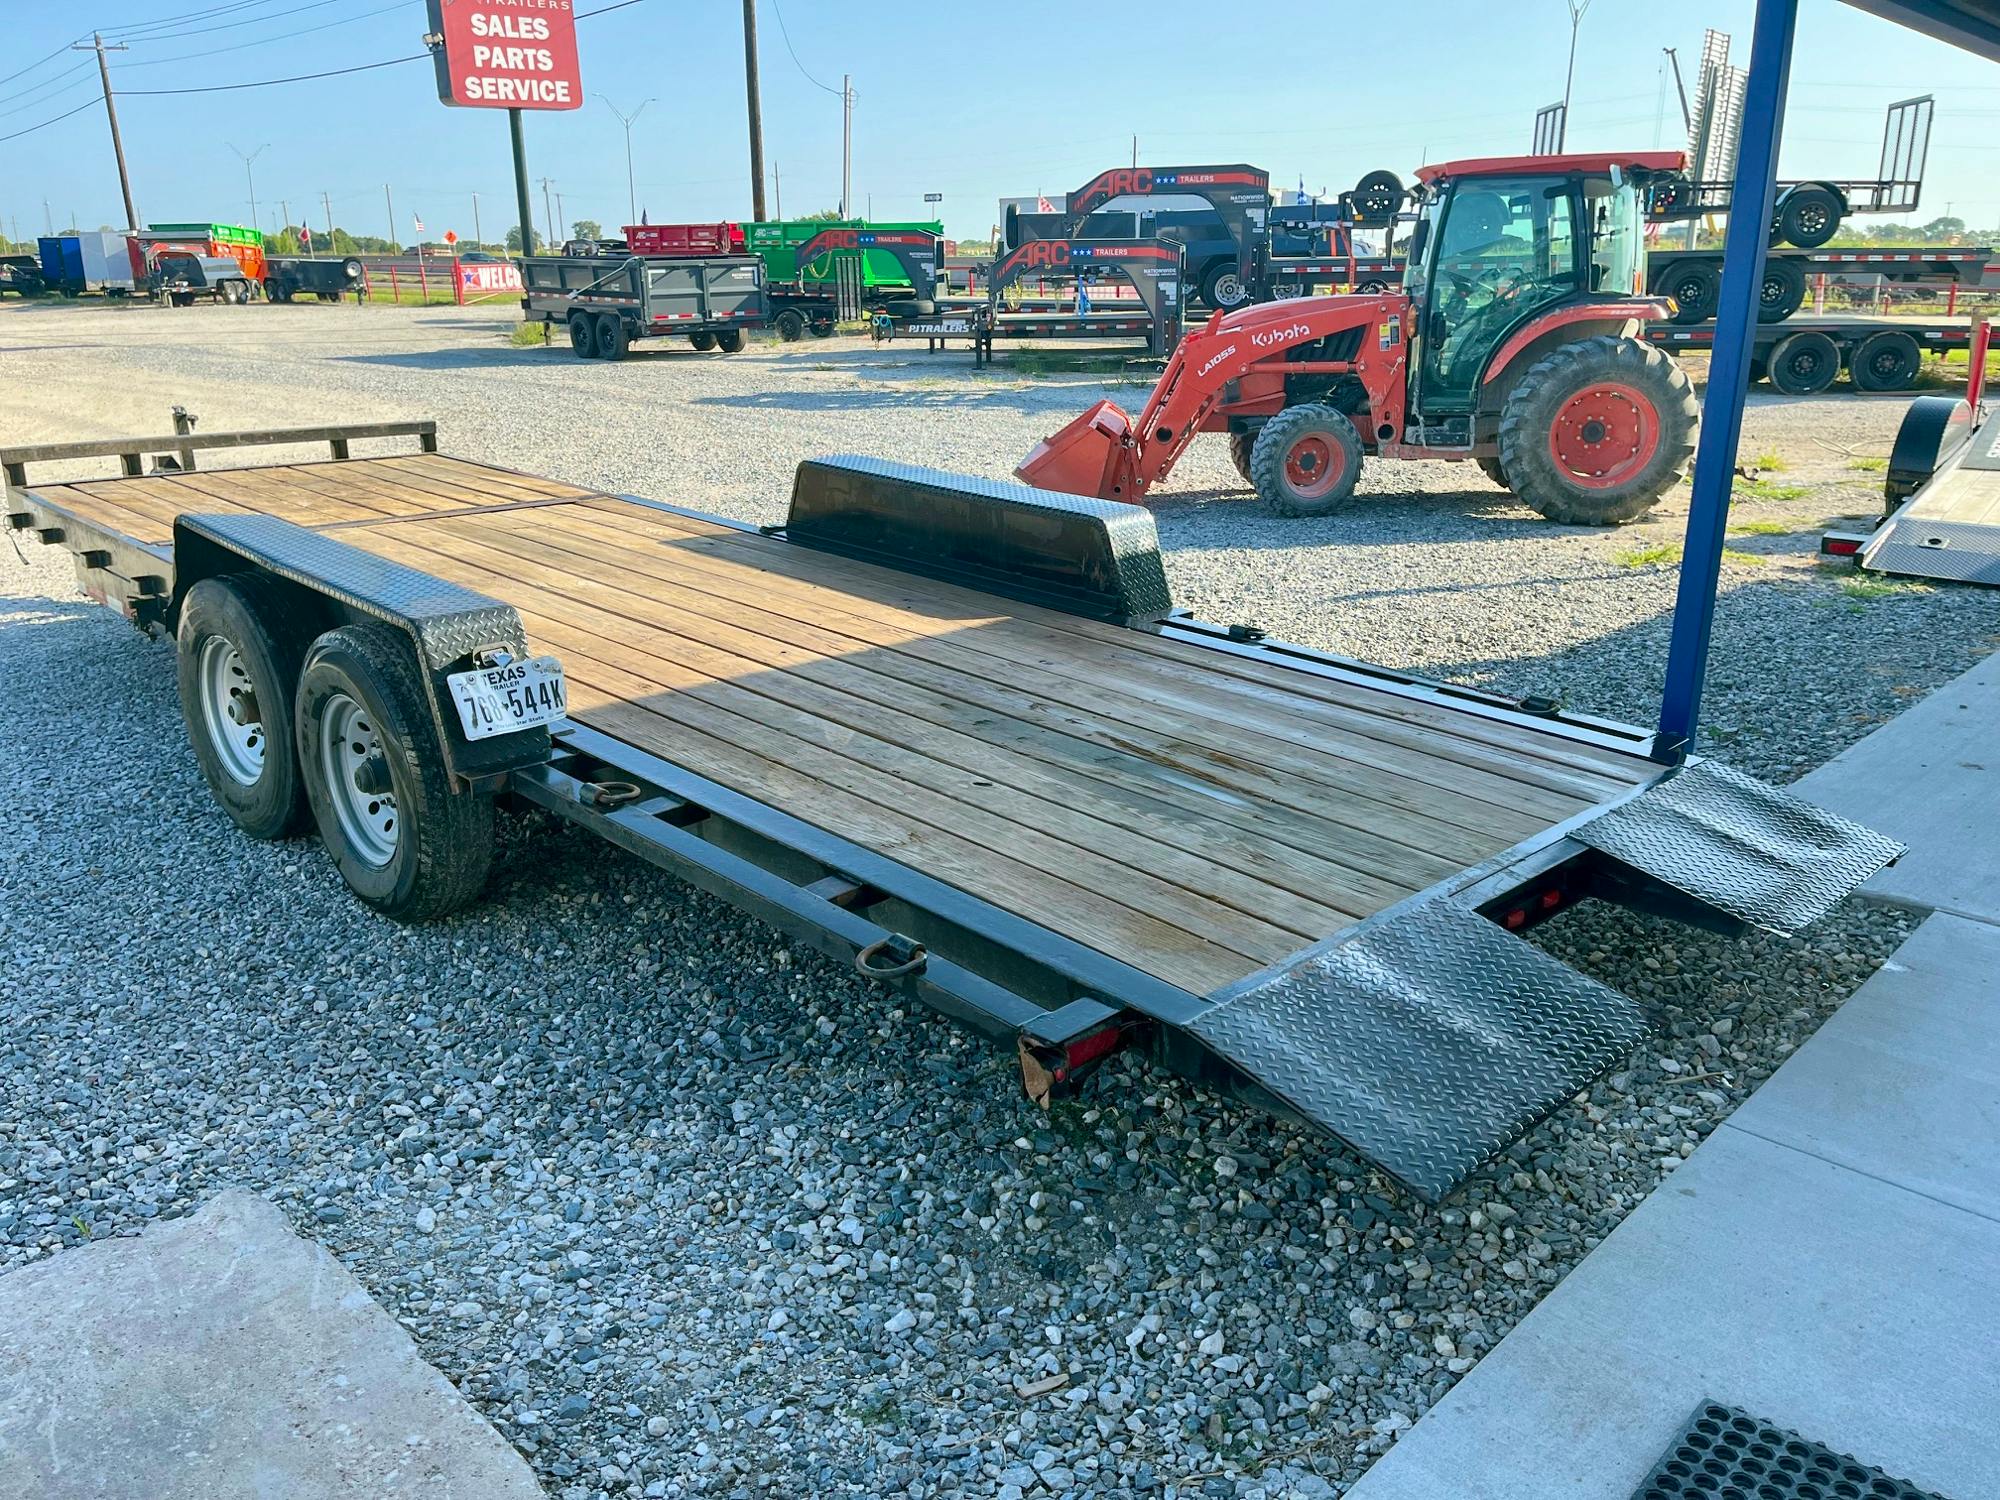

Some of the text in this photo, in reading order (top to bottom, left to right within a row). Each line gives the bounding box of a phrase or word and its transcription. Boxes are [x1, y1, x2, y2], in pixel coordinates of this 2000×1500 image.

[470, 13, 550, 40] SALES
[473, 45, 554, 71] PARTS
[464, 76, 571, 103] SERVICE
[1084, 169, 1214, 201] ARC TRAILERS
[807, 230, 858, 250] ARC
[1006, 241, 1069, 269] ARC
[1251, 324, 1311, 347] Kubota
[1197, 344, 1236, 377] LA1055
[481, 666, 526, 686] TEXAS
[490, 680, 520, 691] TRAILER
[528, 715, 545, 723] State
